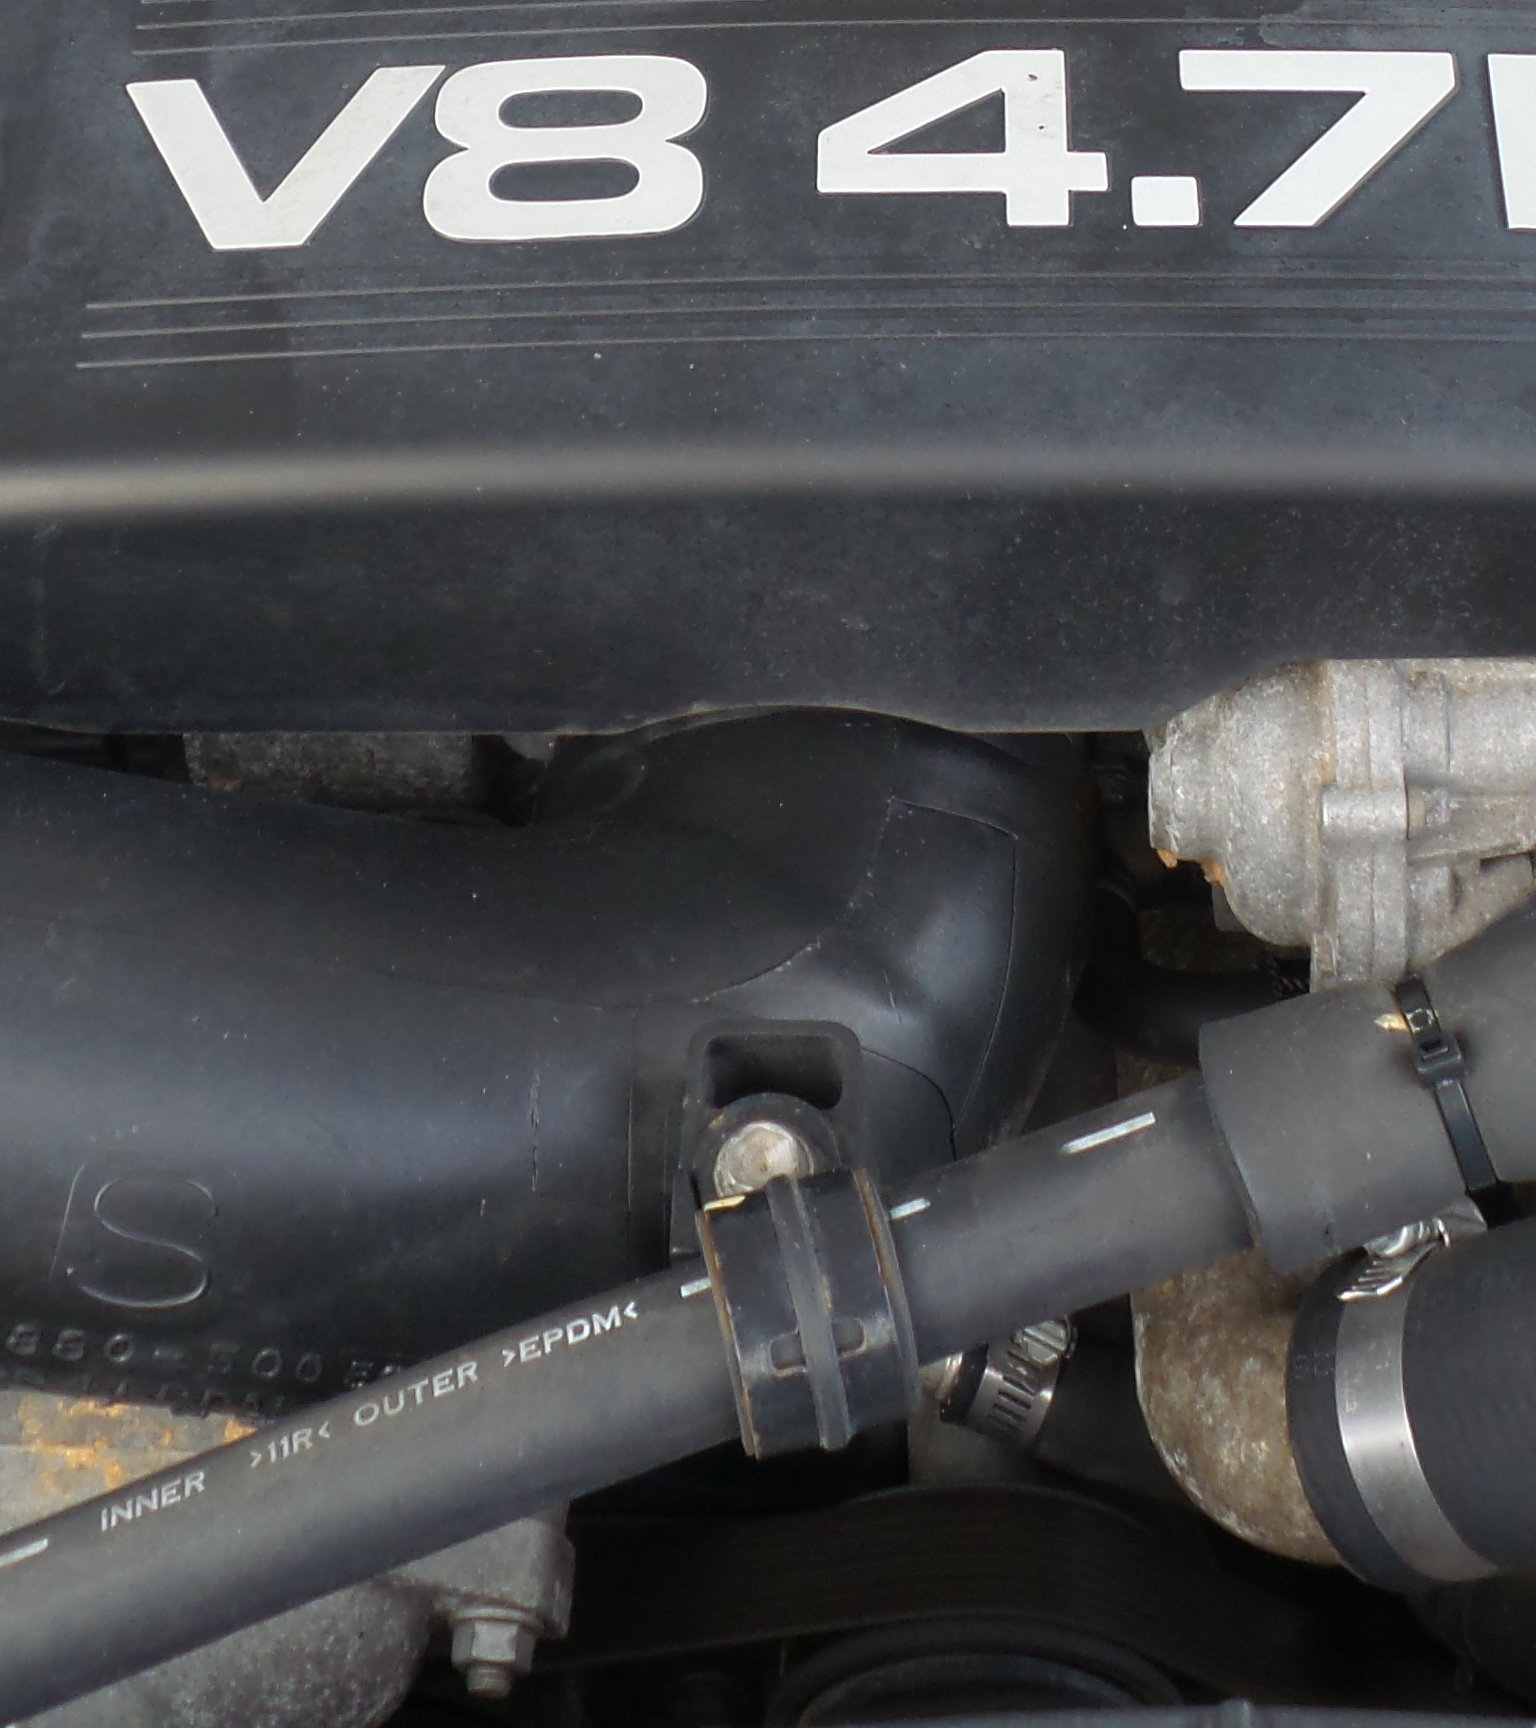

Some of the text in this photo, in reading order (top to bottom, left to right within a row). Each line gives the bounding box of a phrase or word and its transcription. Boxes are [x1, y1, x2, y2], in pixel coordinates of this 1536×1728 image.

[128, 54, 708, 252] V8
[100, 1472, 207, 1532] INNER
[352, 1360, 480, 1427] OUTER
